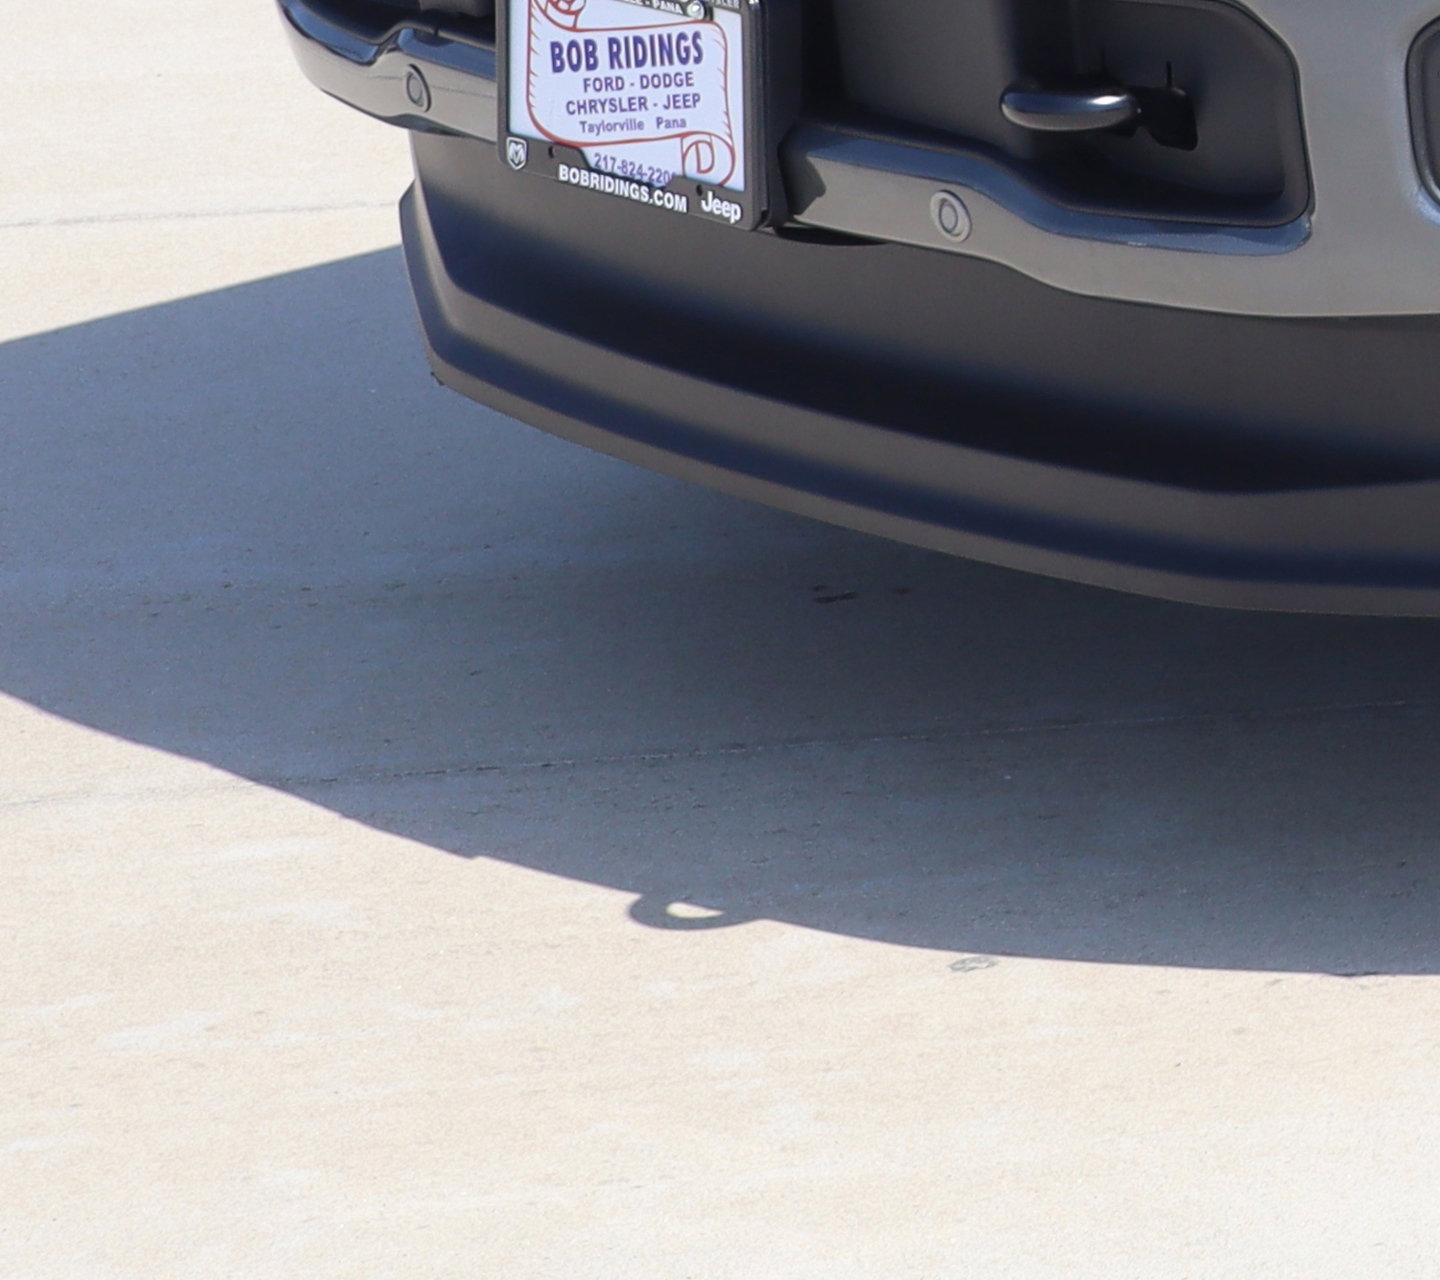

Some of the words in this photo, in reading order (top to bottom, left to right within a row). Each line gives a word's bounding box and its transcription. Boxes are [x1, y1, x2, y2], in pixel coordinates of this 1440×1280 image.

[550, 38, 599, 74] BOB
[607, 30, 704, 70] RIDINGS
[583, 75, 625, 93] FORD
[639, 71, 695, 90] DODGE
[566, 96, 649, 116] CHRYSLER
[662, 92, 701, 110] JEEP
[579, 118, 645, 136] Taylorville
[656, 116, 687, 130] Pana
[558, 163, 688, 213] BOBRIDINGS.COM
[701, 191, 742, 223] Jeep
